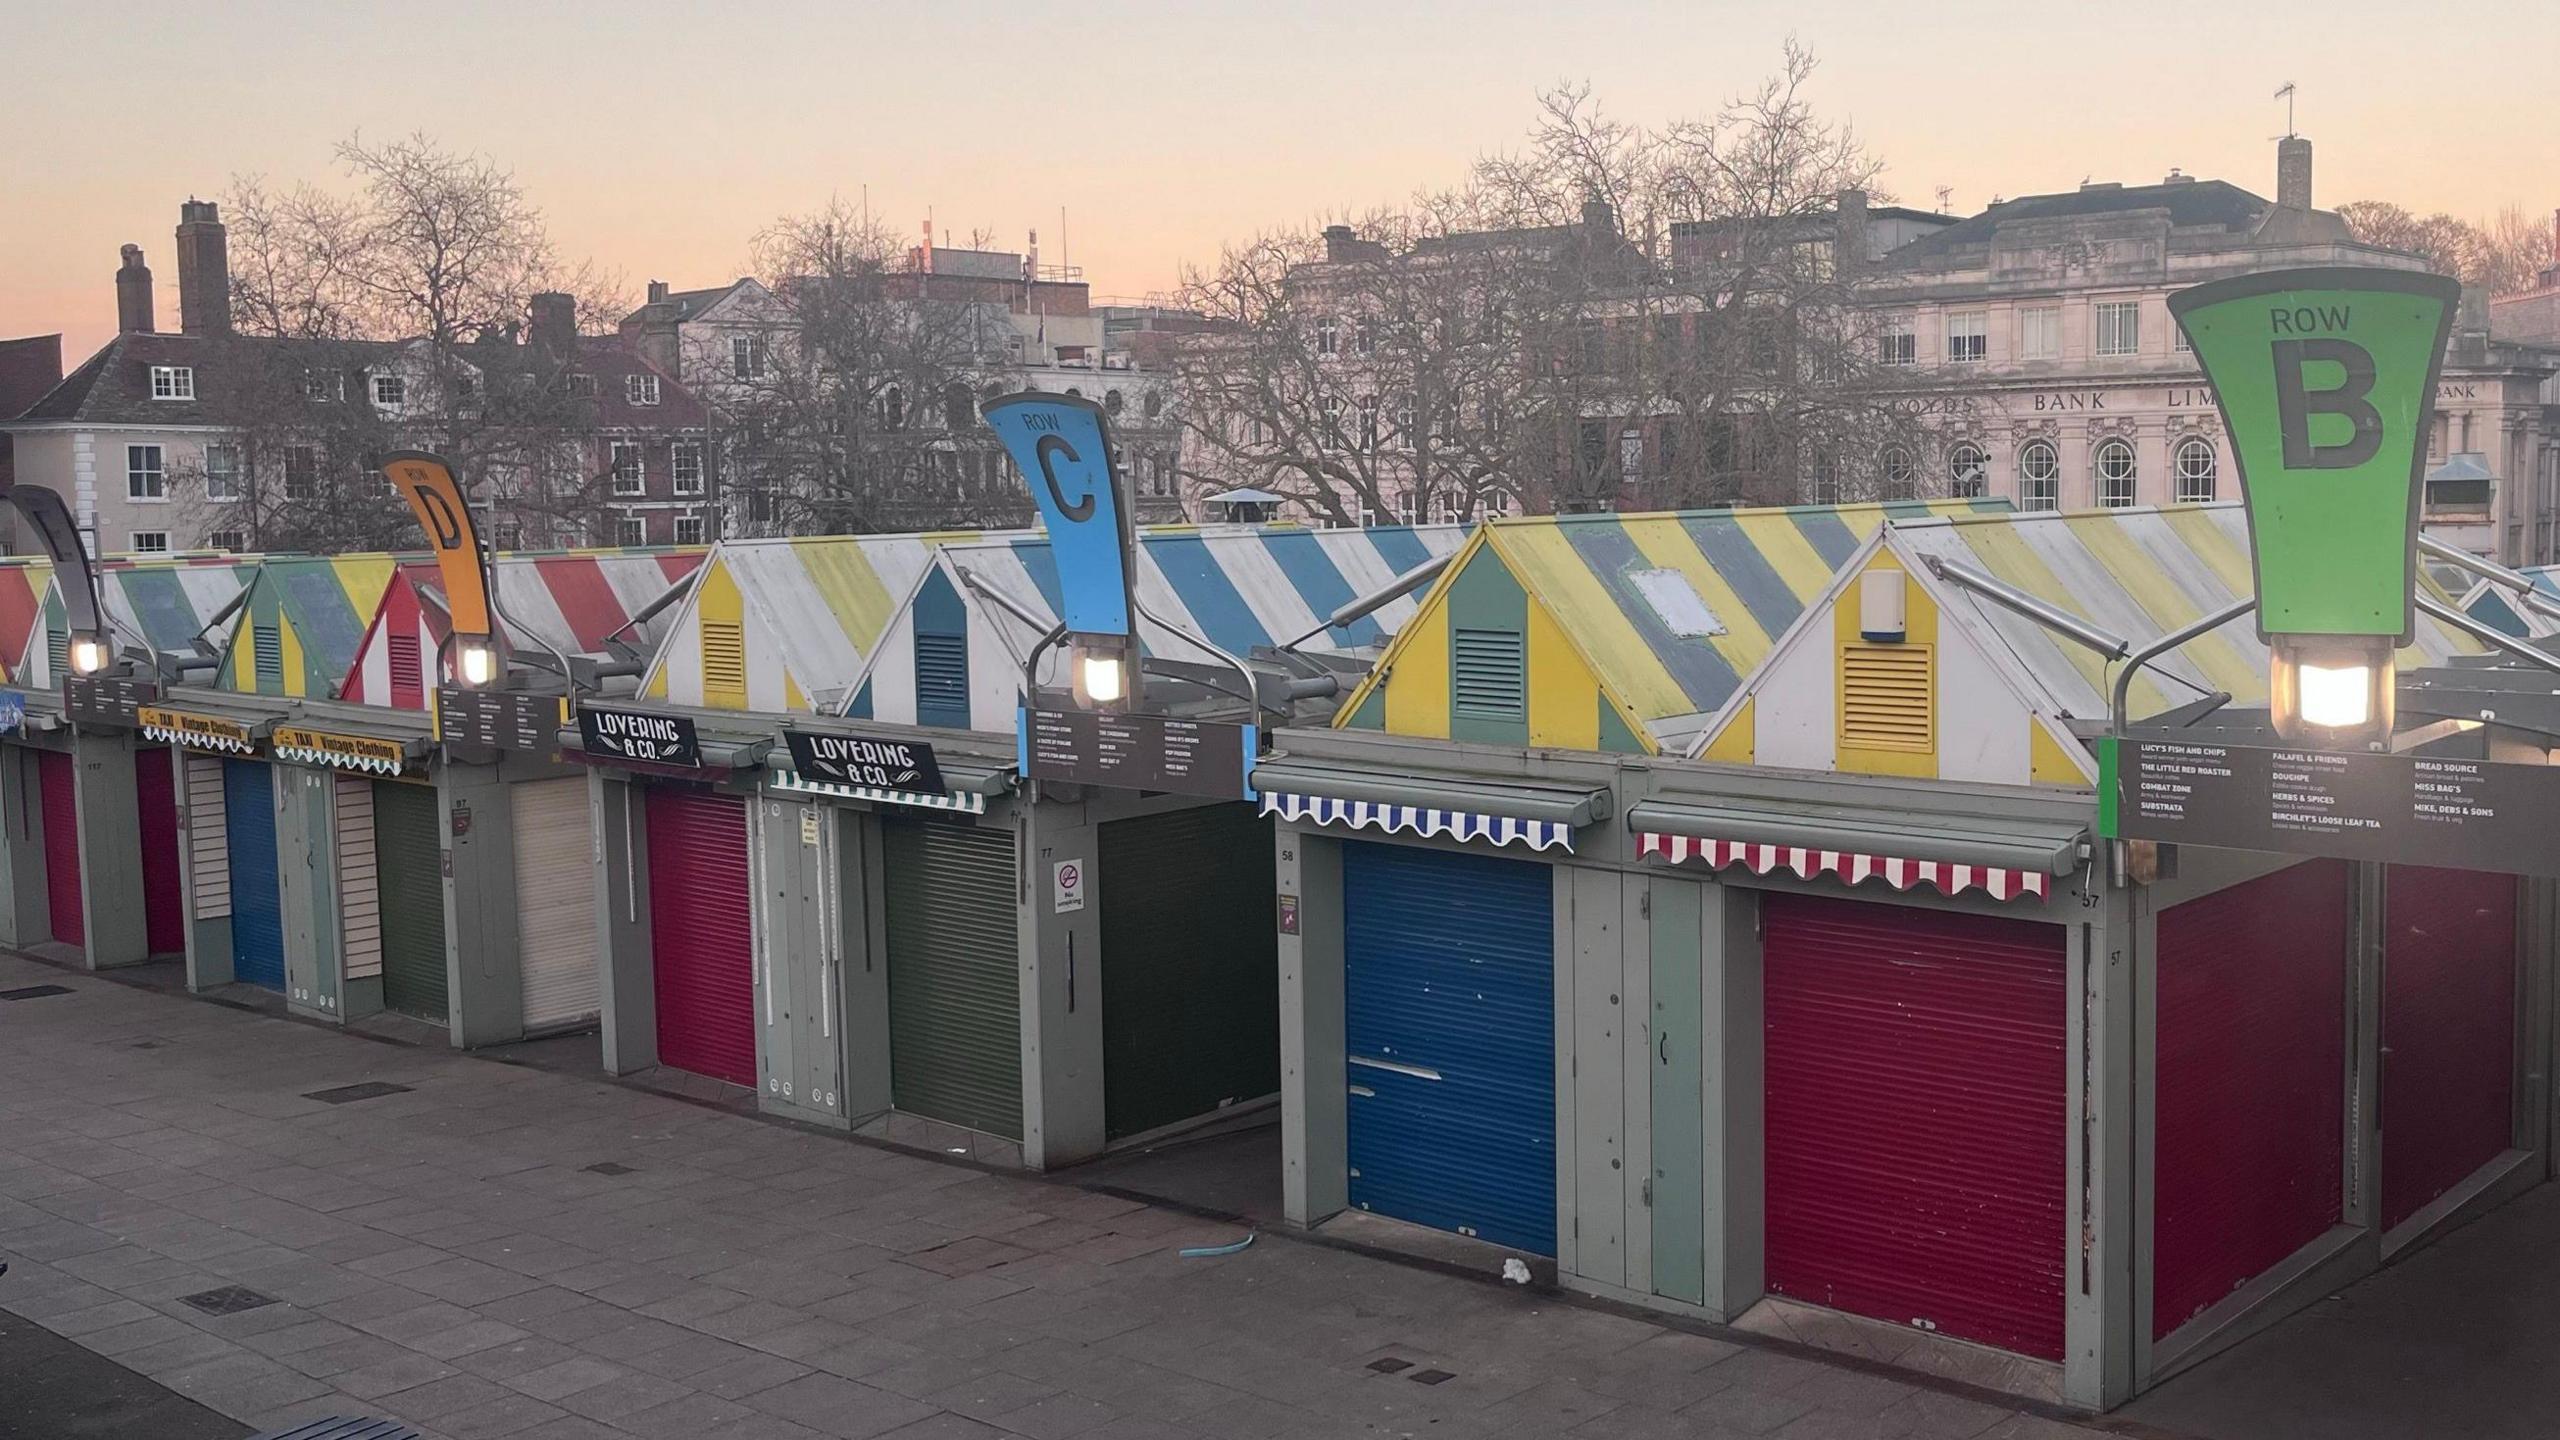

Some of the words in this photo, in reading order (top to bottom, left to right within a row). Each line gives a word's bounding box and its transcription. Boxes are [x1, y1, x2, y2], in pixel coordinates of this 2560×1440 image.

[2270, 305, 2350, 334] ROW
[2034, 393, 2105, 411] BANK
[2271, 338, 2384, 471] B
[1021, 412, 1060, 431] ROW
[404, 467, 429, 481] ROW
[1036, 434, 1095, 523] C
[414, 485, 461, 549] D
[181, 716, 210, 733] Vintage
[210, 720, 241, 739] Clothing
[596, 713, 679, 741] LOVERING
[320, 735, 355, 754] Vintage
[356, 740, 395, 760] Clothing
[809, 737, 915, 767] LOVERING
[2141, 744, 2167, 753] LUCY'S
[2168, 745, 2185, 754] FISH
[2186, 747, 2202, 755] AND
[2203, 748, 2226, 756] CHIPS
[2272, 753, 2305, 762] FALAFEL
[2314, 756, 2348, 764] FRIENDS
[2141, 763, 2155, 771] THE
[2156, 764, 2180, 773] LITTLE
[2182, 766, 2196, 774] RED
[2197, 767, 2232, 776] ROASTER
[2415, 762, 2442, 771] BREAD
[2444, 764, 2477, 773] SOURCE
[2141, 782, 2171, 791] COMBAT
[2172, 784, 2192, 793] ZONE
[2415, 783, 2435, 791] MISS
[2437, 784, 2461, 793] BAG'S
[2272, 793, 2298, 802] HERBS
[2307, 796, 2335, 804] SPICES
[2141, 802, 2183, 812] SUBSTRATA
[2415, 803, 2437, 814] MIKE,
[2439, 805, 2461, 814] DEBS
[2463, 807, 2468, 815] &
[2470, 808, 2494, 817] SONS
[2272, 812, 2317, 823] BIRCHLEY'S
[2318, 816, 2343, 825] LOOSE
[2345, 818, 2364, 827] LEAF
[2365, 820, 2381, 828] TEA
[1041, 847, 1052, 858] 77
[1282, 850, 1294, 861] 58
[2083, 894, 2099, 908] 57
